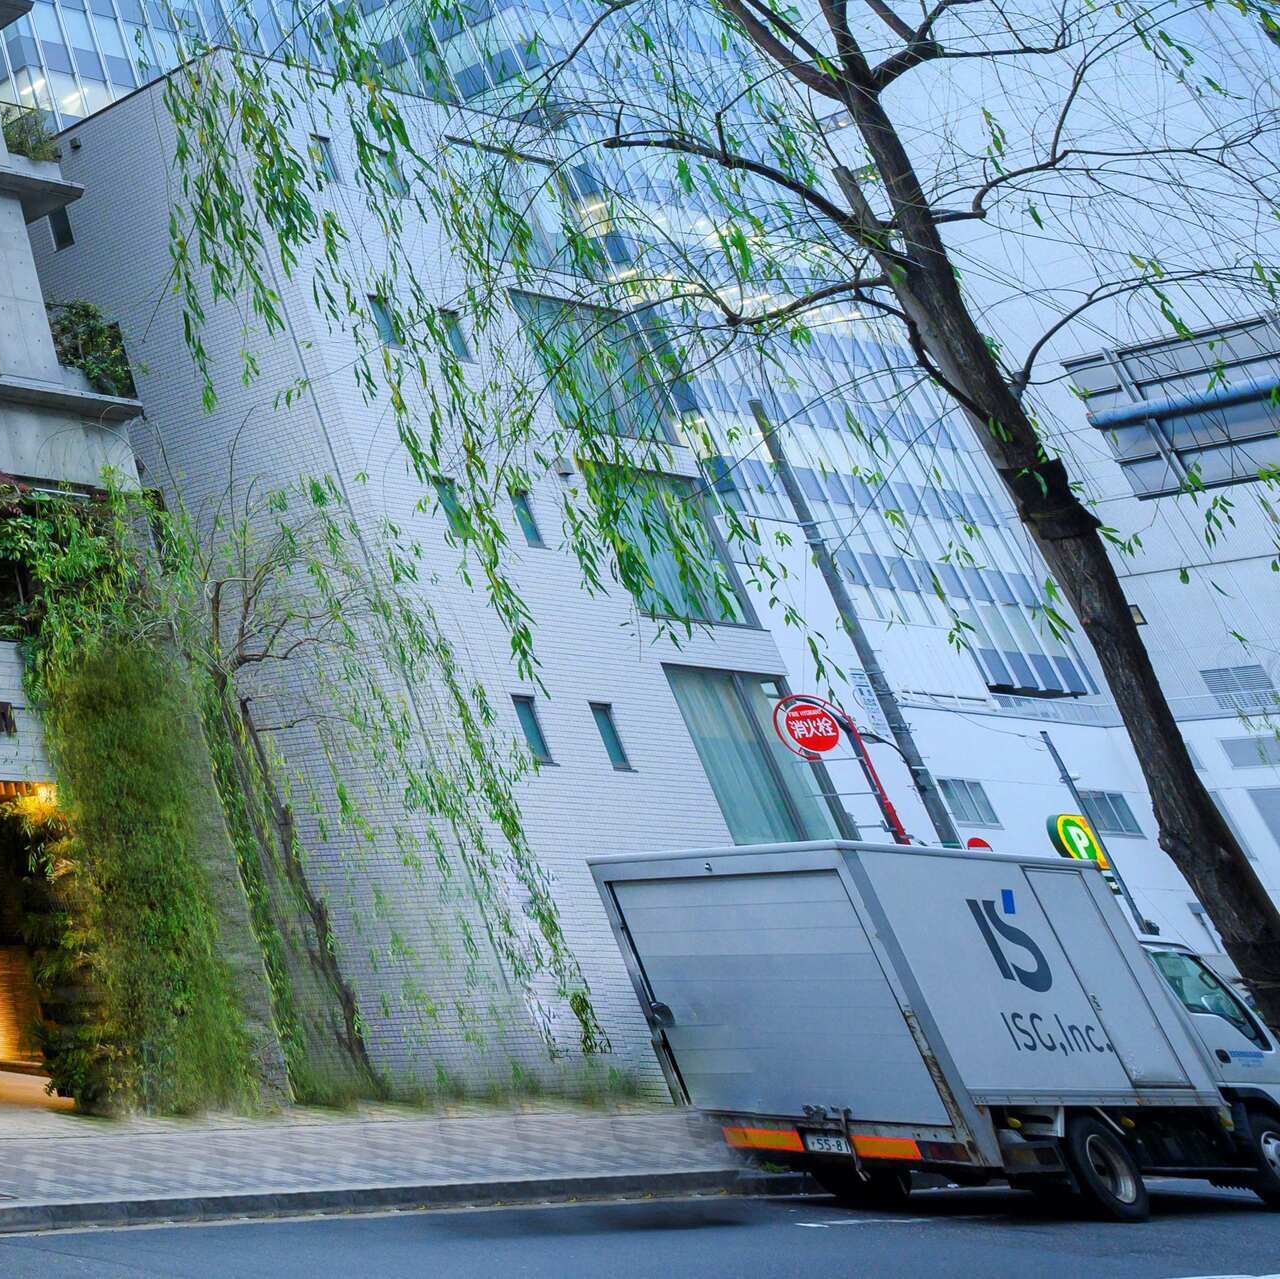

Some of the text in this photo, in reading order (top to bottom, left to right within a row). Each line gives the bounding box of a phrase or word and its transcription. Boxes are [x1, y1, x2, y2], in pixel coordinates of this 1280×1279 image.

[788, 717, 837, 739] 消火栓
[1066, 825, 1090, 860] P
